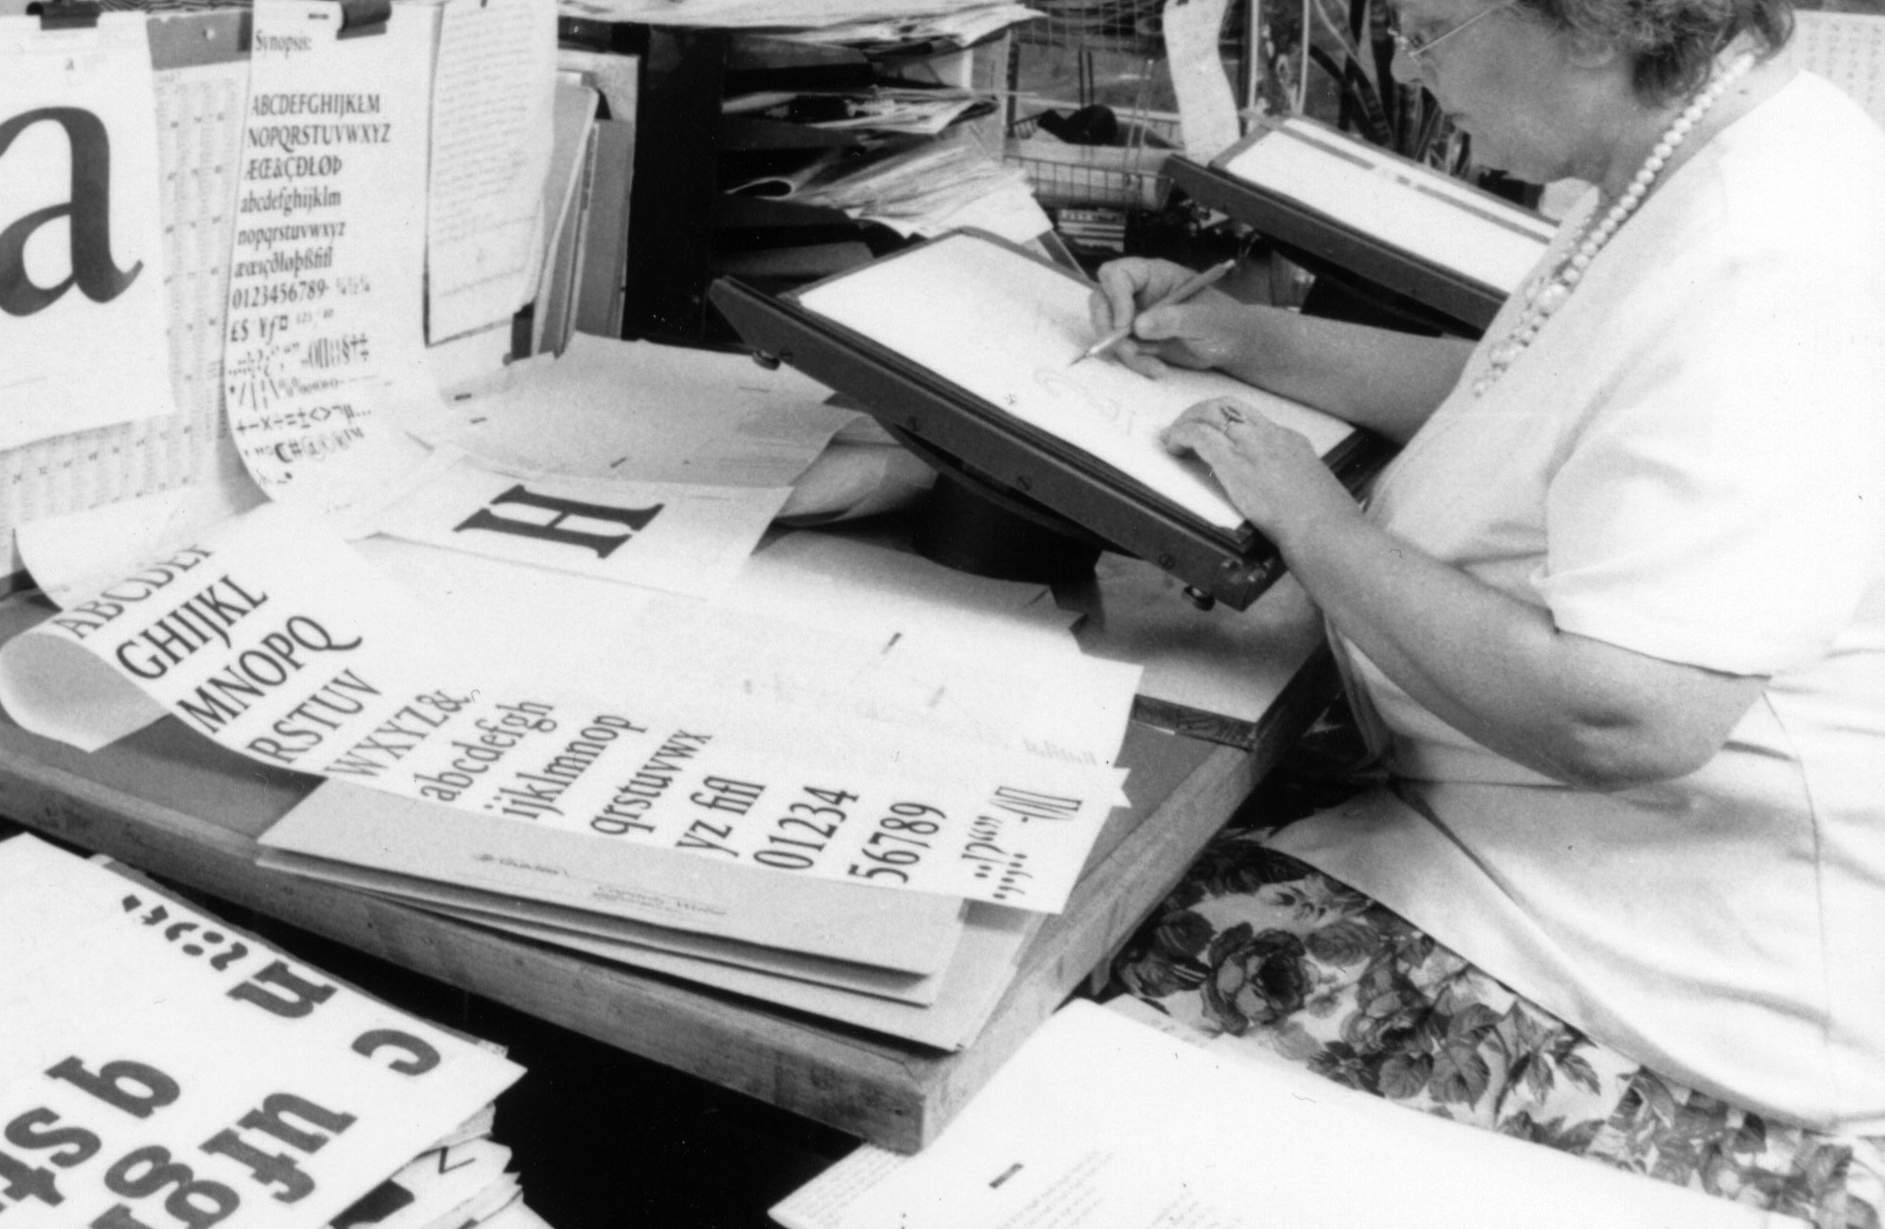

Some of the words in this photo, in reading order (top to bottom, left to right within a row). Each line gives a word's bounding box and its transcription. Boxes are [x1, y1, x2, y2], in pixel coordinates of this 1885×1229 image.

[248, 122, 392, 154] NOPQRSTUVWXYZ
[451, 483, 668, 560] H
[115, 574, 269, 681] GHIJKL
[175, 615, 364, 734] MNOPQ
[245, 669, 383, 764] RSTUV
[323, 689, 472, 779] WXYZ&
[419, 699, 559, 804] abcdefgh
[483, 712, 649, 821] ijklmnop
[589, 729, 715, 837] qrstuvwx
[752, 784, 861, 872] 01234
[847, 800, 948, 885] 56789
